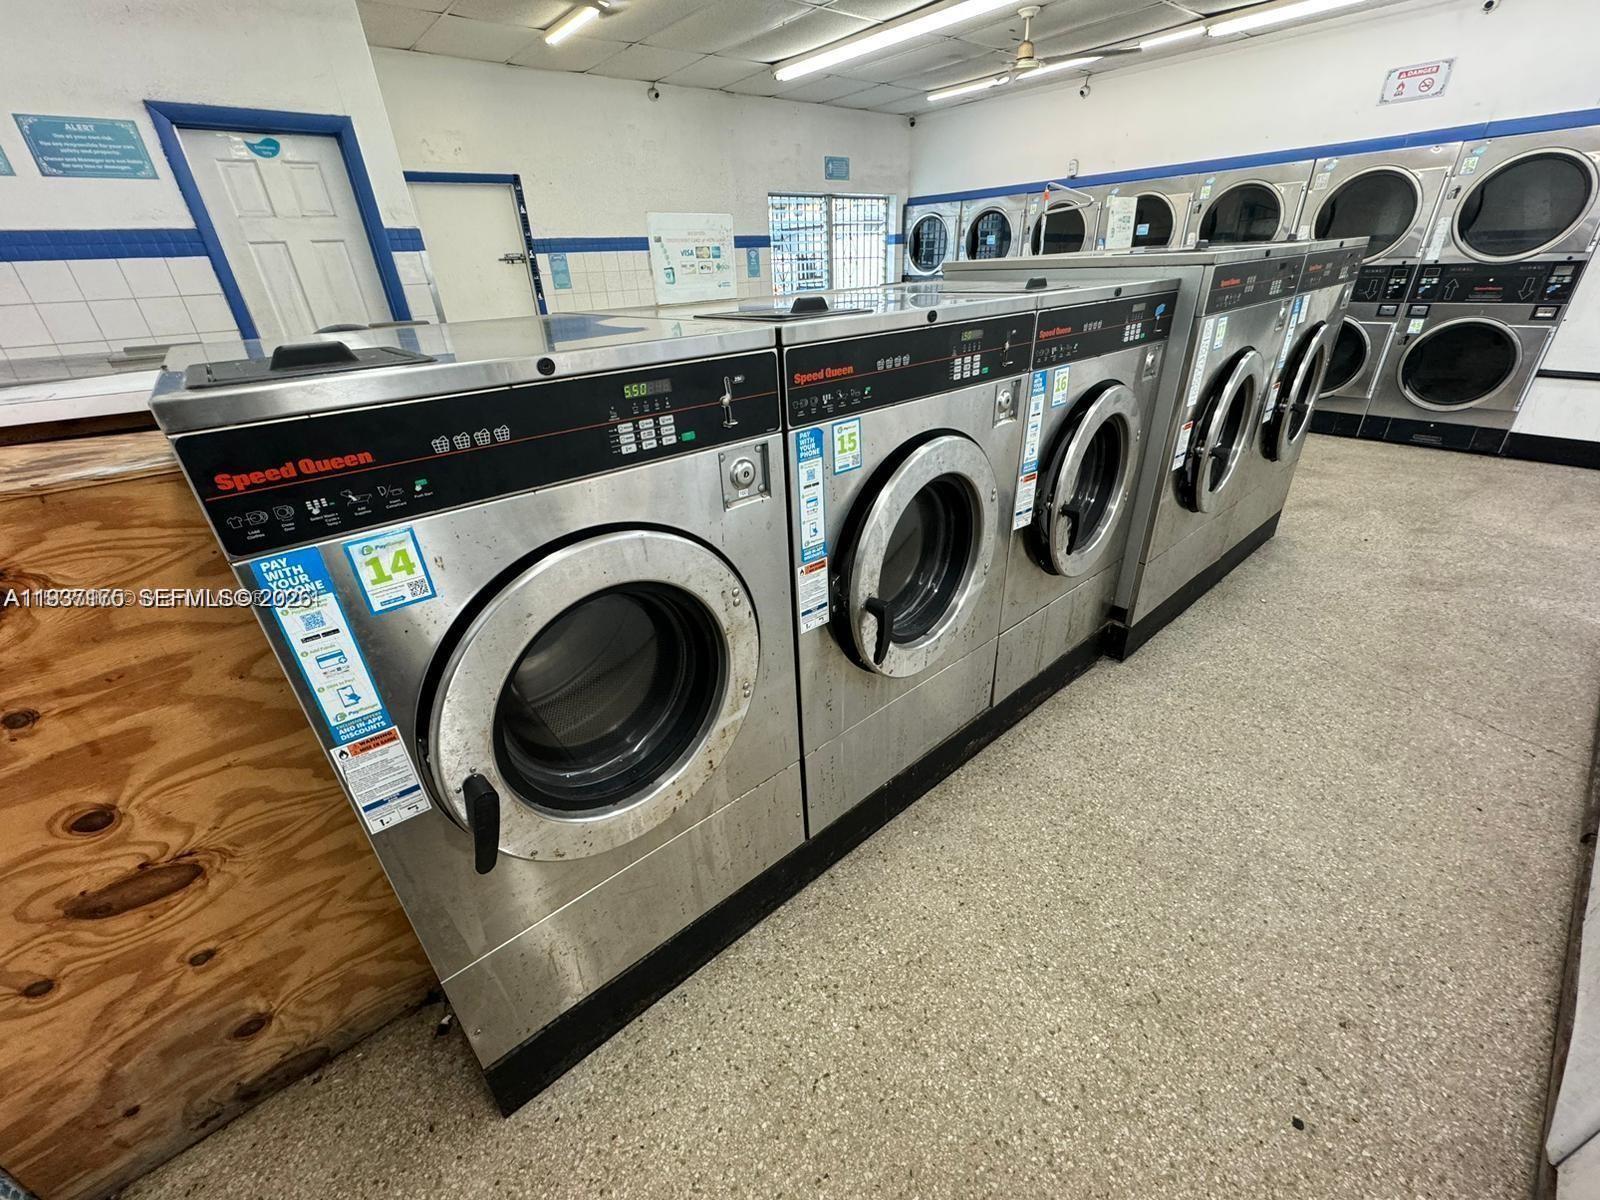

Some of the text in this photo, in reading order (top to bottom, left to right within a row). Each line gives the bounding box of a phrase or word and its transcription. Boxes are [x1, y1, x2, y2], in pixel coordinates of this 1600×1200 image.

[64, 123, 96, 132] ALERT
[793, 365, 854, 385] Speed Queen
[1055, 376, 1067, 393] 16
[799, 431, 811, 439] PAY
[800, 437, 815, 446] WITH
[837, 432, 858, 455] 15
[800, 443, 816, 453] YOUR
[800, 448, 820, 459] PHONE
[213, 451, 375, 491] Speed Queen
[259, 557, 288, 572] PAY
[365, 548, 416, 586] 14
[264, 565, 304, 582] WITH
[268, 574, 311, 592] YOUR
[339, 716, 383, 736] AND IN-APP
[340, 720, 386, 741] DISCOUNTS
[359, 731, 393, 746] WARNING
